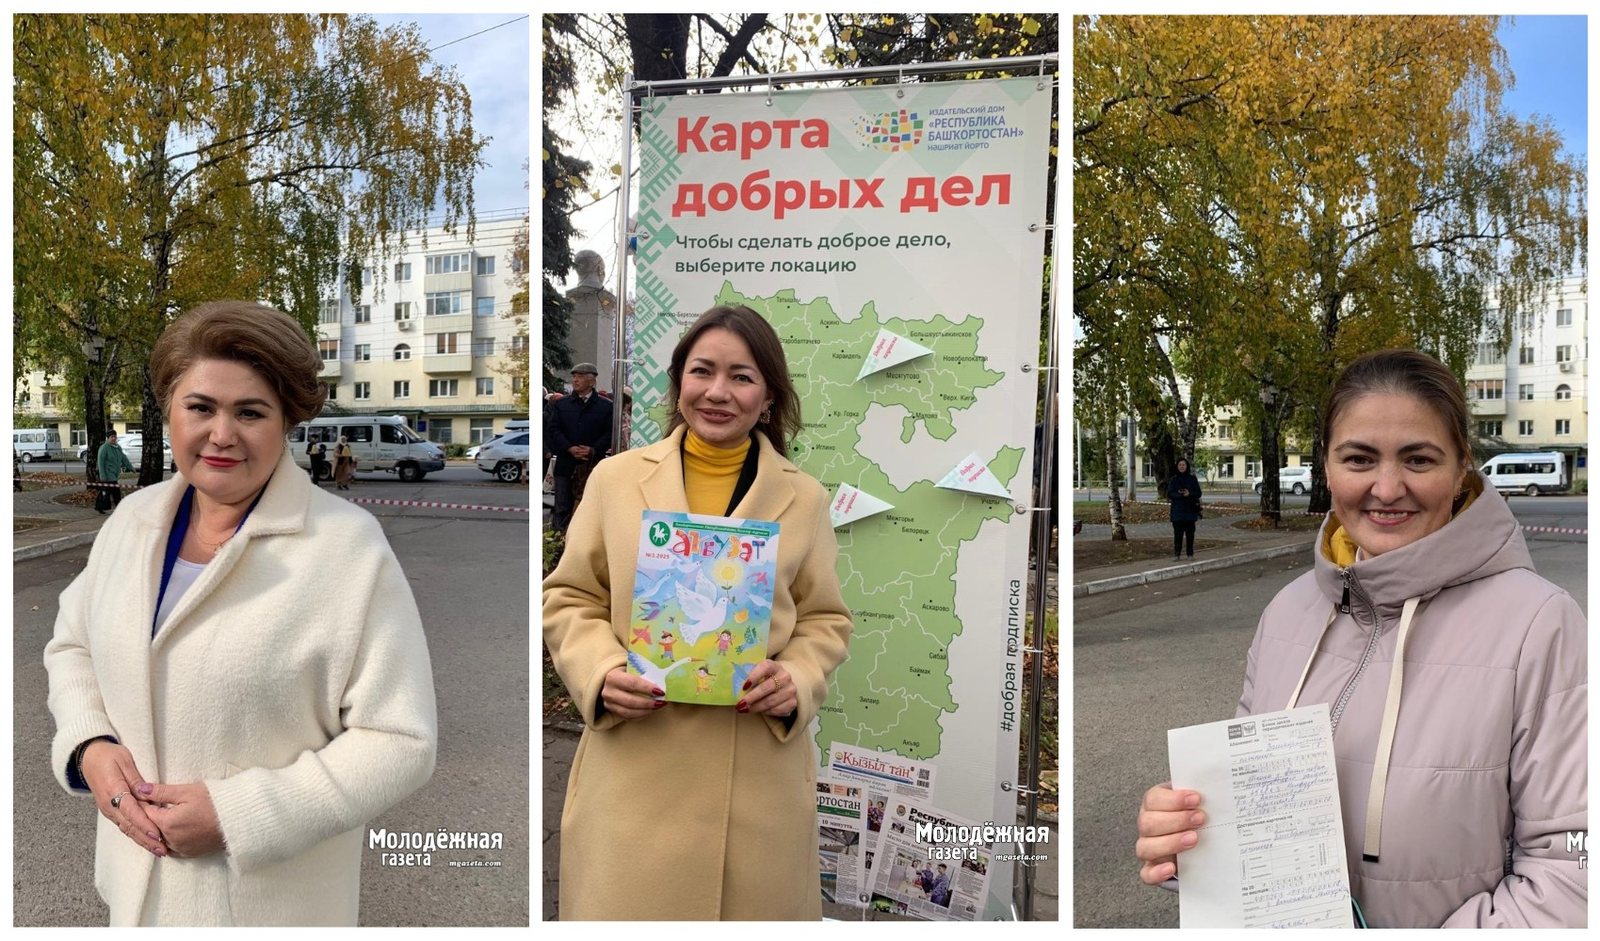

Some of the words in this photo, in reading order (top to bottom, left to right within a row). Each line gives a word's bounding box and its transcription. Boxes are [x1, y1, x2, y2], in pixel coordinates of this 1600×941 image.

[928, 105, 986, 116] ИЗДАТЕЛЬСКИЙ
[987, 105, 1005, 114] ДОМ
[928, 116, 1006, 129] «РЕСПУБЛИКА
[677, 115, 829, 160] Карта
[963, 140, 990, 151] ЙОРТО
[671, 169, 885, 220] добрых
[899, 173, 1012, 214] дел
[676, 235, 733, 250] Чтобы
[738, 235, 812, 251] сделать
[817, 232, 891, 251] доброе
[896, 232, 952, 250] дело,
[675, 257, 765, 274] выберите
[770, 257, 857, 275] локацию
[832, 352, 861, 360] Караидель
[886, 372, 920, 380] Месягутово
[886, 515, 914, 523] Межгорье
[922, 603, 949, 612] Аскарово
[1007, 579, 1021, 657] подписка
[929, 652, 947, 660] Сибай
[910, 666, 931, 675] Баймак
[1001, 662, 1018, 732] #добрая
